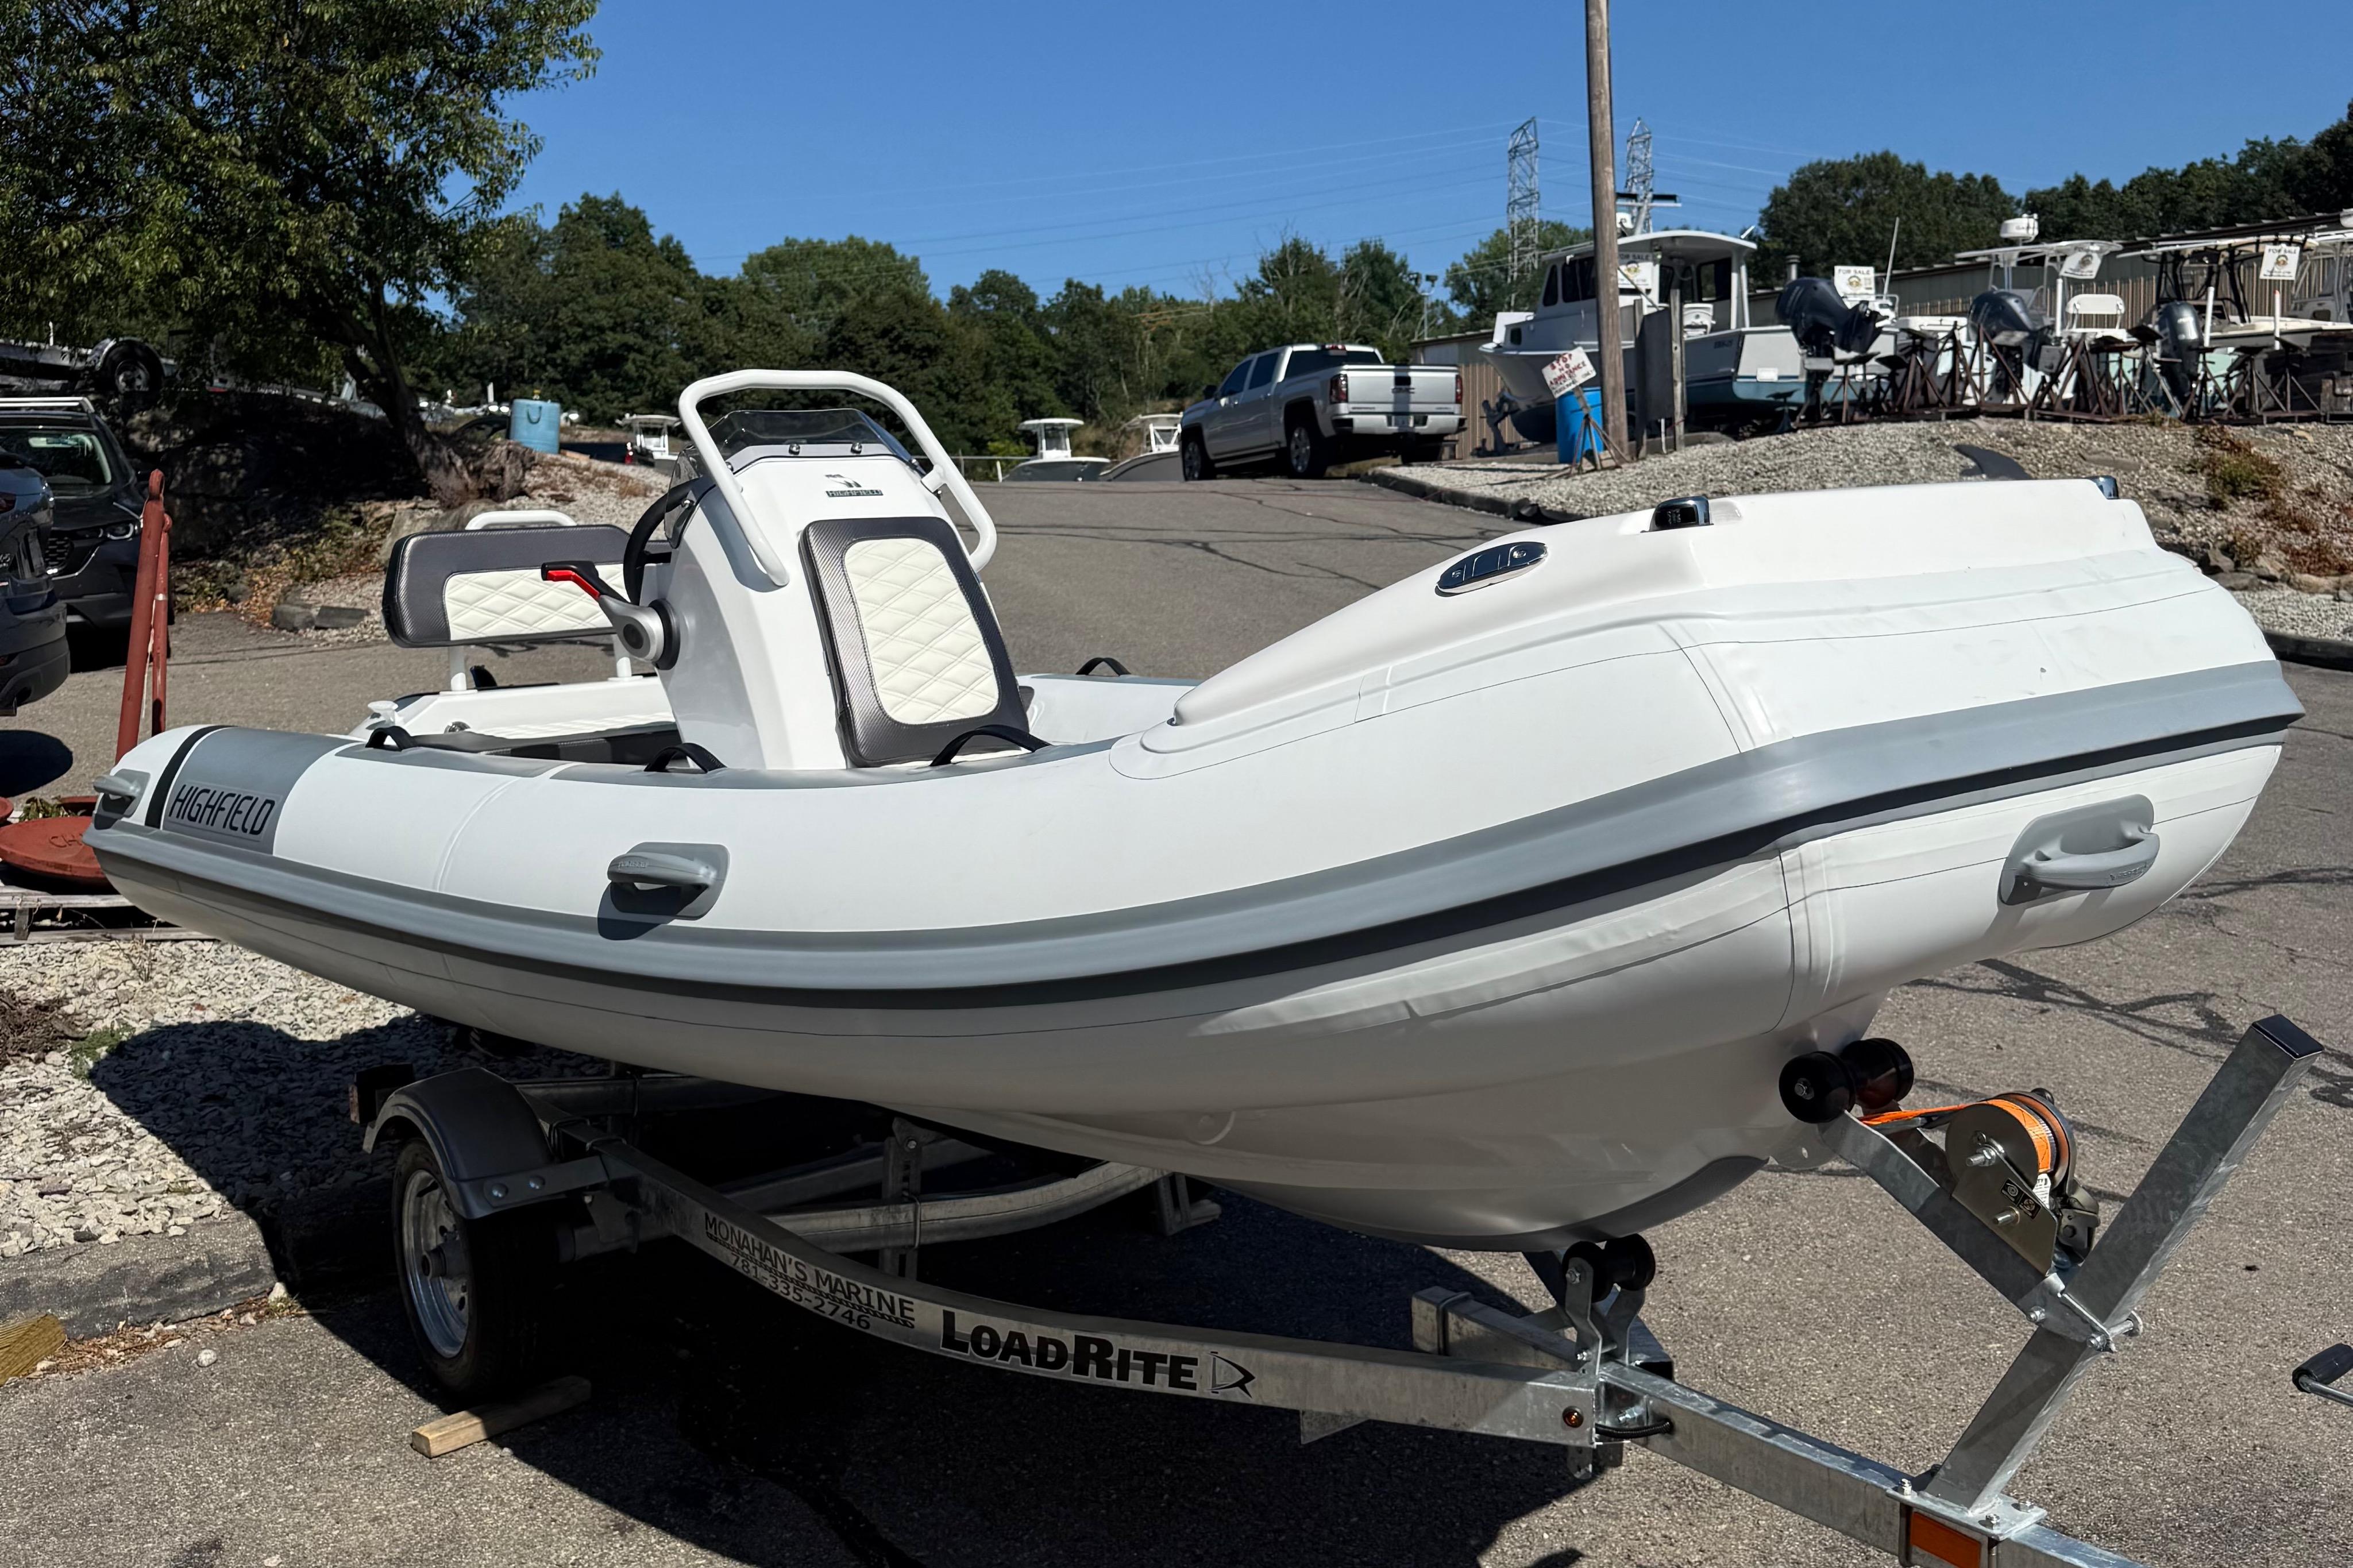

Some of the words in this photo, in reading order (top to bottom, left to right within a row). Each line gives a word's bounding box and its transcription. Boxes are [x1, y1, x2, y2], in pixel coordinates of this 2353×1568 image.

[1550, 353, 1572, 370] STOP
[1559, 363, 1570, 373] NO
[168, 785, 275, 835] HIGHFIELD
[705, 1212, 808, 1282] MONAHAN'S
[815, 1268, 915, 1322] MARINE
[731, 1253, 870, 1330] 781-335-2746
[942, 1309, 1198, 1391] LOADRITE
